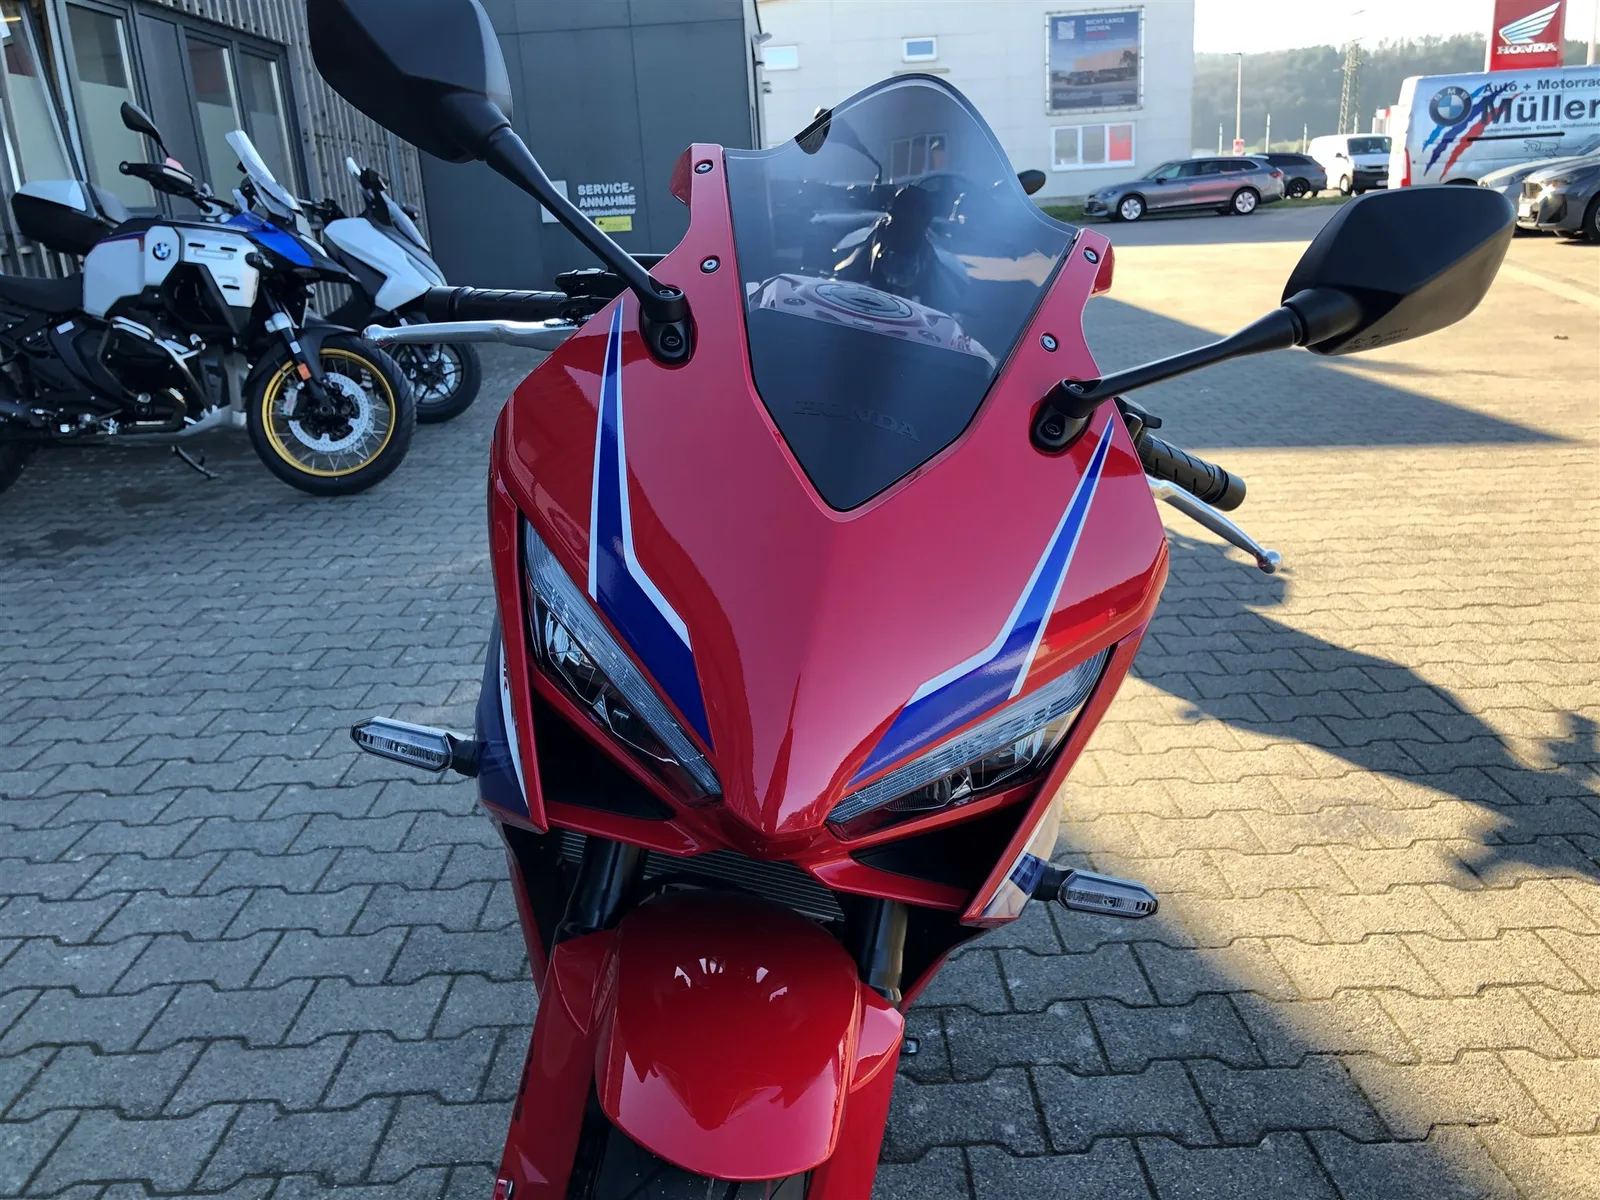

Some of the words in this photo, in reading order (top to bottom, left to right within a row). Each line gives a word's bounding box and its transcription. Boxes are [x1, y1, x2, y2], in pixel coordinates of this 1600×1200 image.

[1496, 42, 1558, 55] HONDA
[1483, 81, 1518, 94] Auto
[1481, 95, 1600, 124] Müller
[577, 182, 635, 196] SERVICE-
[578, 194, 636, 208] ANNAHME
[793, 400, 921, 444] HONDA
